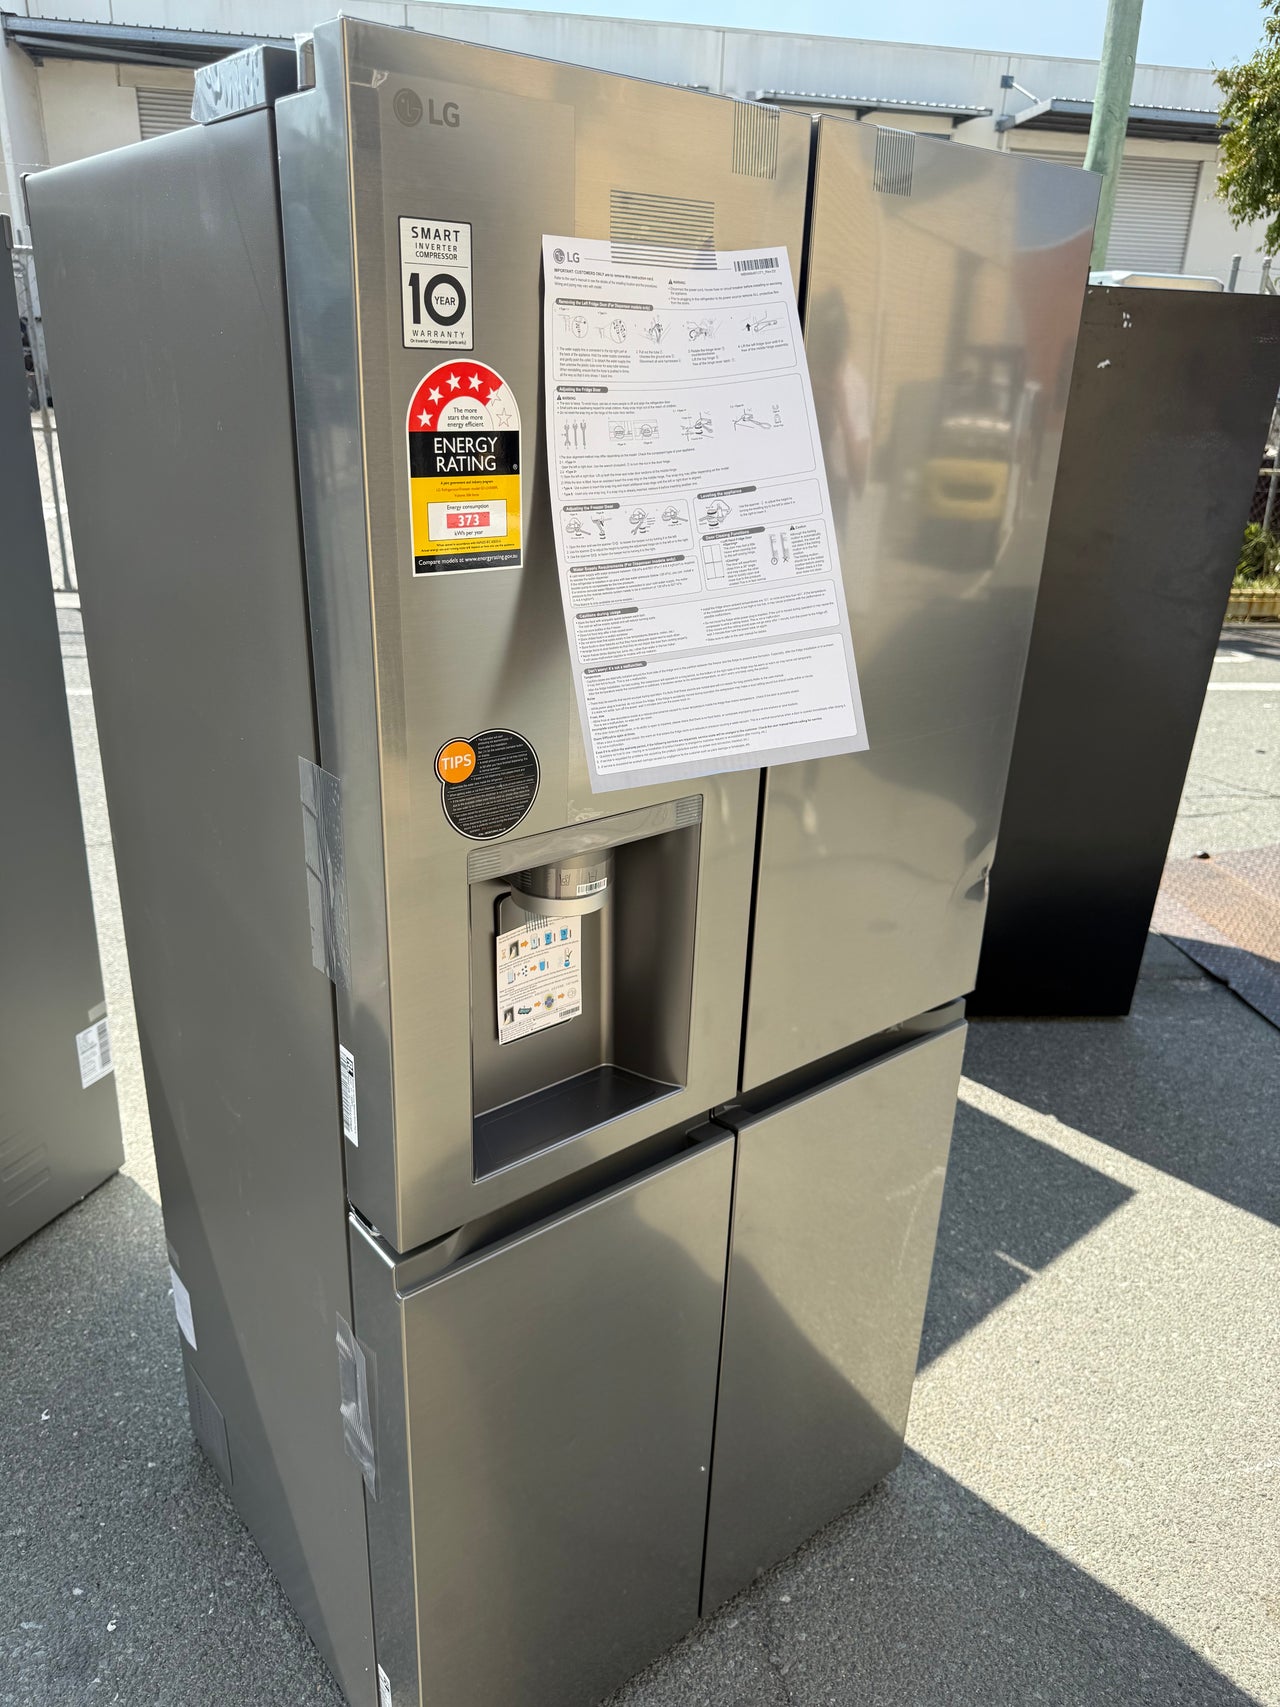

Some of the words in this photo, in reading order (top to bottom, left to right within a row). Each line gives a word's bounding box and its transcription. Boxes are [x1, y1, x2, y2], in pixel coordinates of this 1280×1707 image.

[428, 98, 460, 128] LG
[411, 226, 460, 243] SMART
[415, 242, 458, 253] INVERTER
[415, 251, 458, 261] COMPRESSOR
[566, 251, 580, 263] LG
[407, 272, 467, 327] 10
[433, 295, 456, 307] YEAR
[412, 329, 465, 339] WARRANTY
[433, 436, 498, 454] ENERGY
[436, 455, 498, 473] RATING
[458, 514, 480, 527] 373
[418, 558, 441, 567] Compare
[441, 753, 473, 771] TIPS
